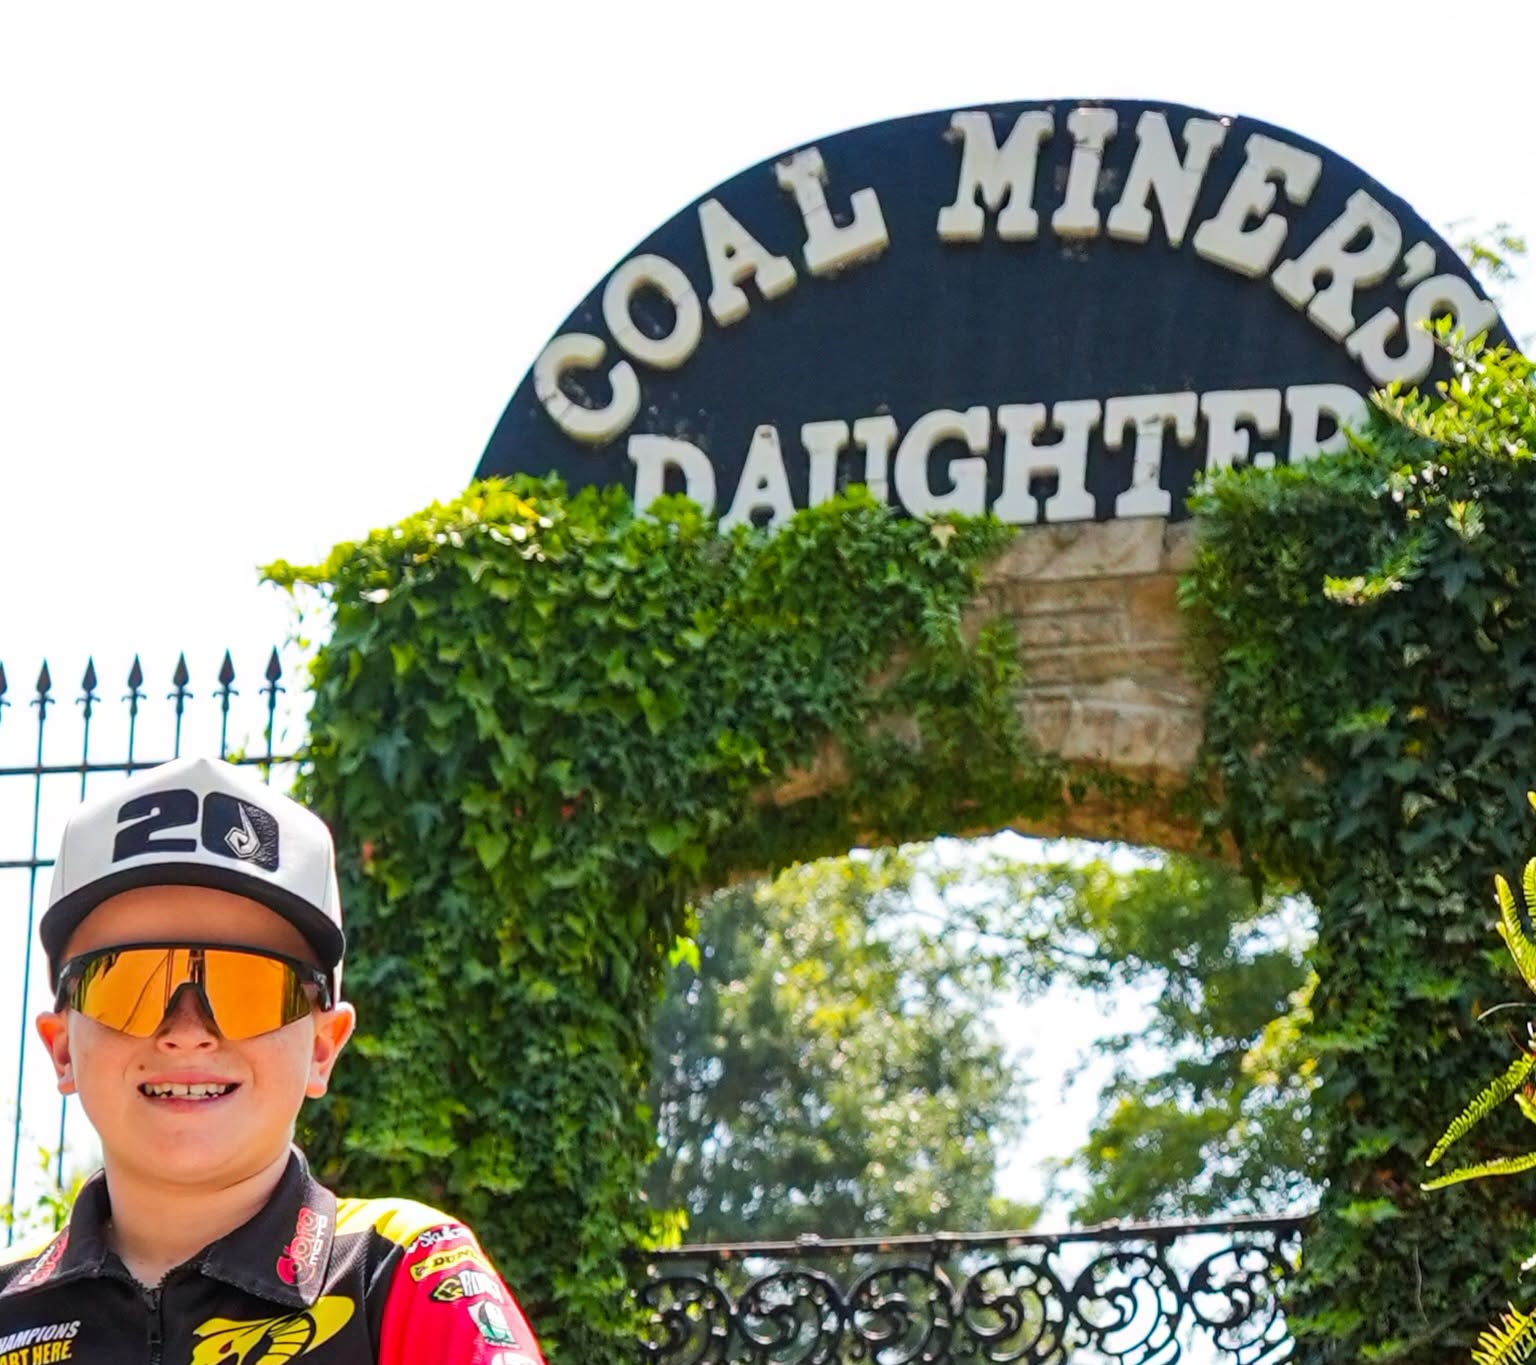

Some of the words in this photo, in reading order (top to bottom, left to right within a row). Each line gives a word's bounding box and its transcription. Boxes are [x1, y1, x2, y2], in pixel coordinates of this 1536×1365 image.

[534, 146, 889, 443] COAL
[936, 107, 1498, 387] MINER'S
[112, 788, 280, 873] 20
